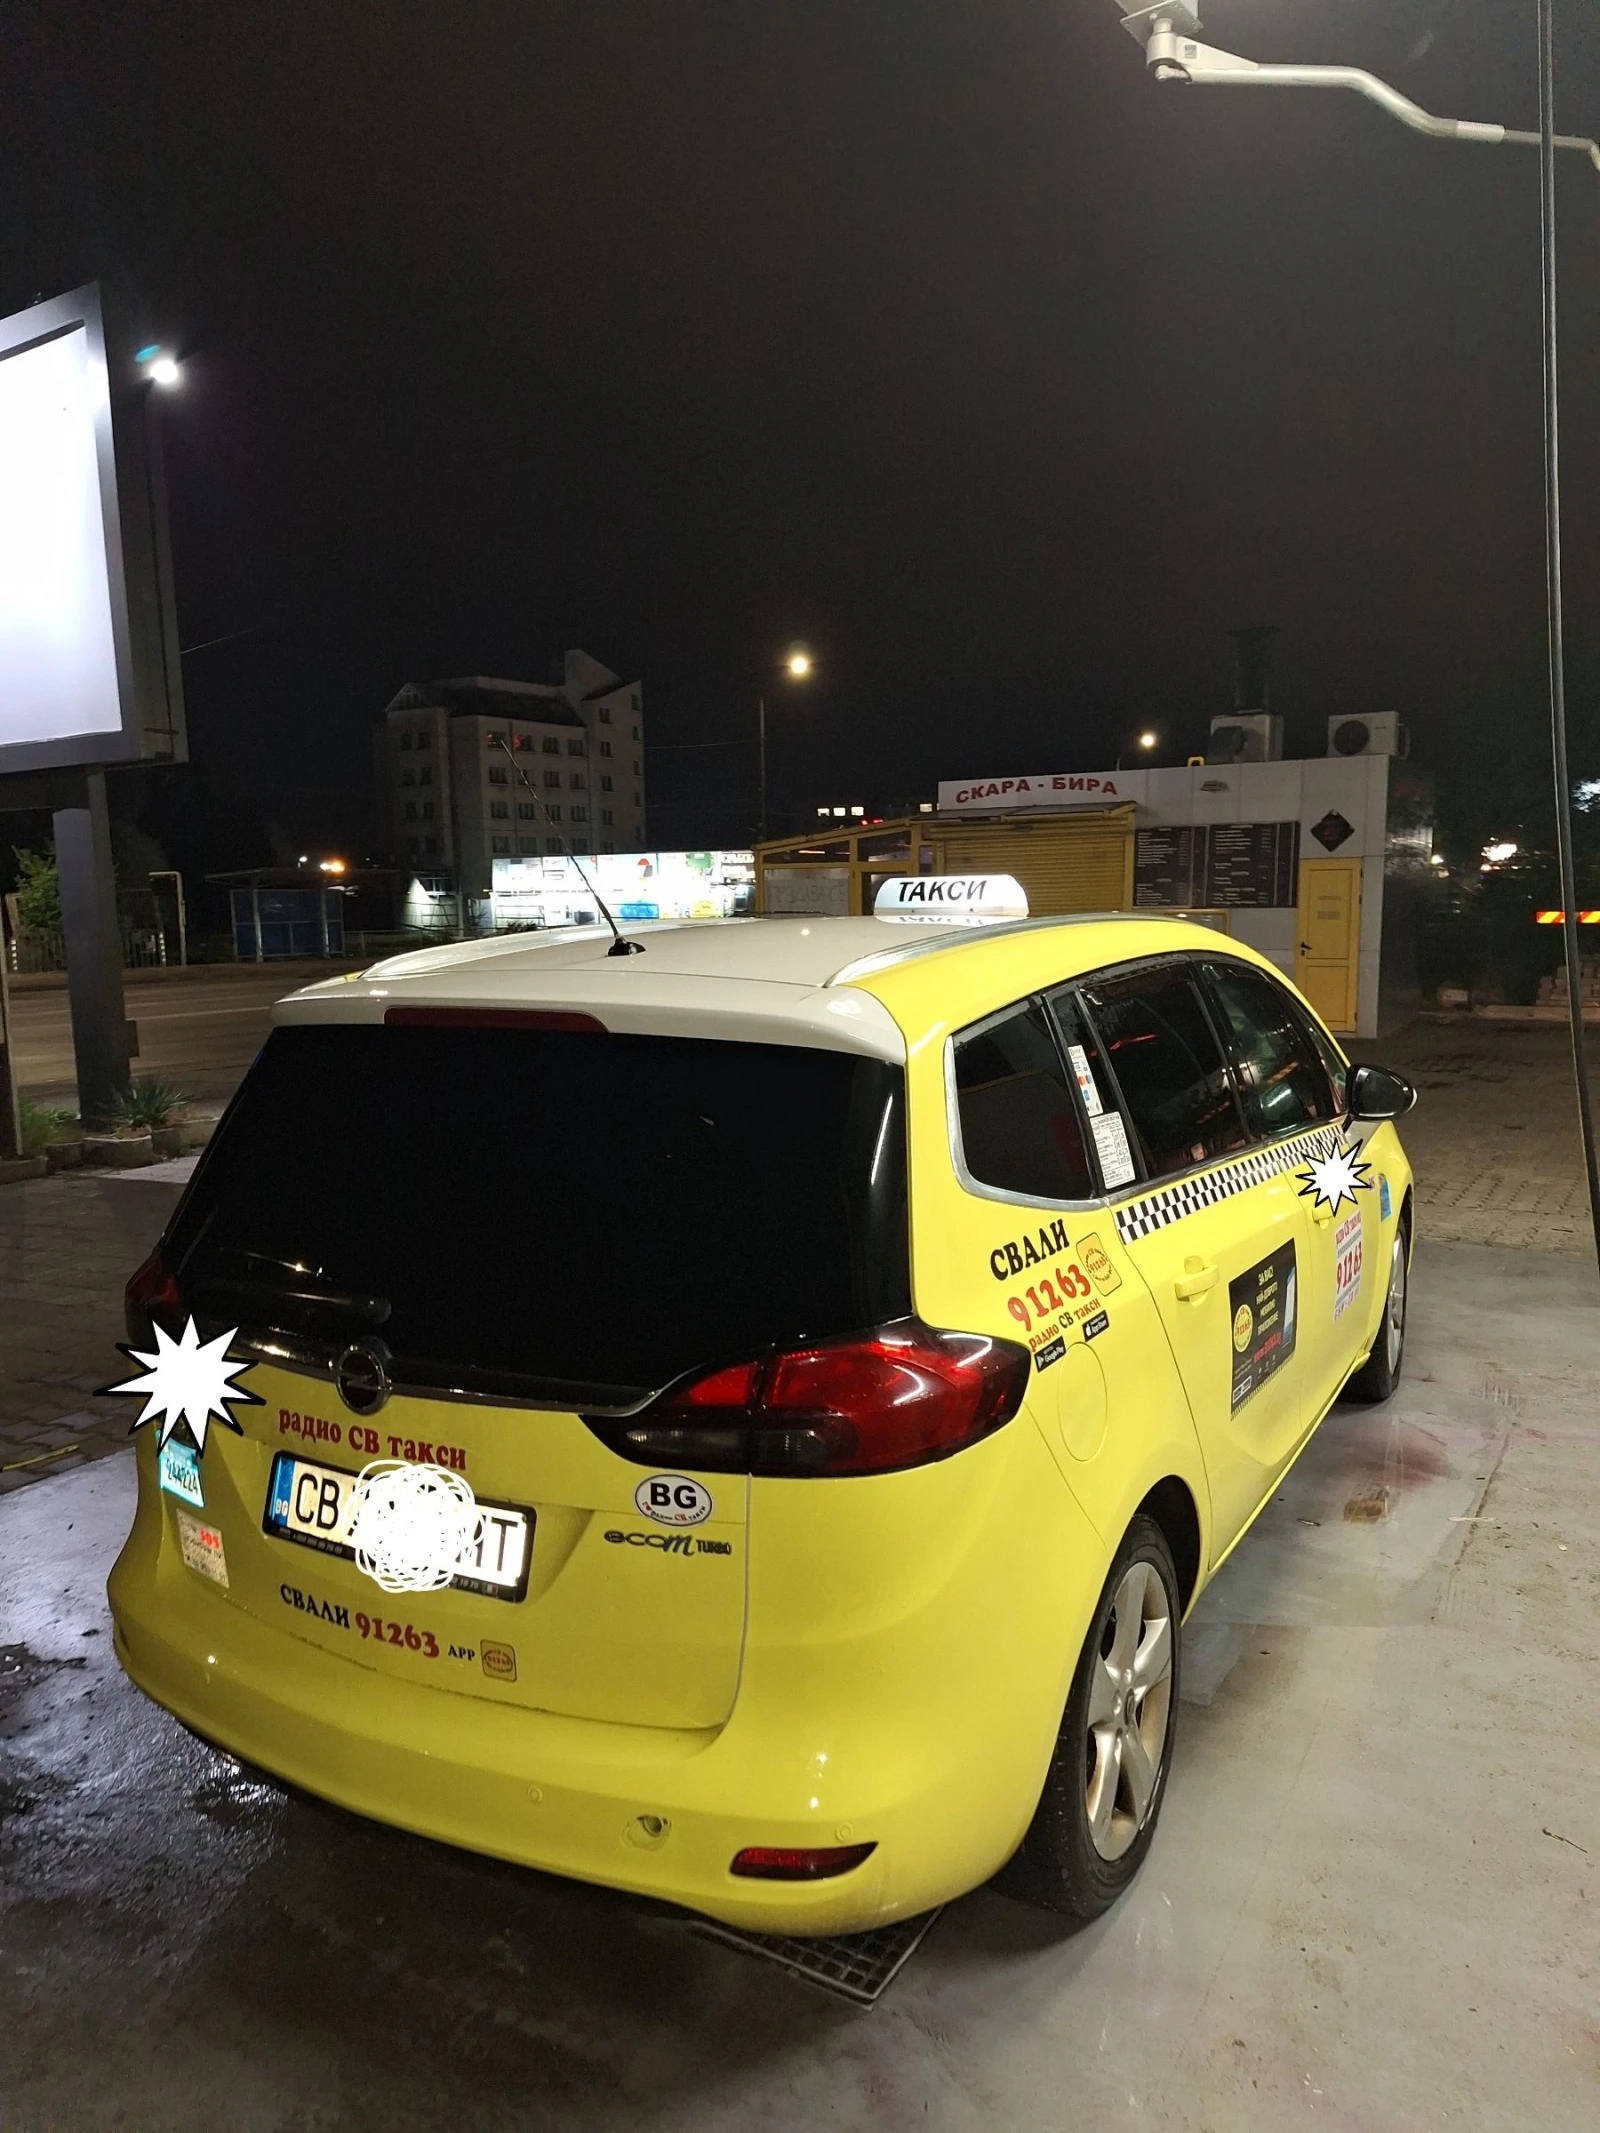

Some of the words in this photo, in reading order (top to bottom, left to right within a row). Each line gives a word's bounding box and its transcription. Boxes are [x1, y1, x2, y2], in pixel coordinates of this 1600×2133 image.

[956, 779, 1031, 803] СКАРА
[1052, 777, 1118, 795] БИРА
[899, 880, 987, 902] ТАКСИ
[990, 1218, 1070, 1281] СВАЛИ
[1336, 1241, 1362, 1294] 91263
[1008, 1264, 1091, 1331] 91263
[1028, 1324, 1060, 1353] радио
[1058, 1311, 1074, 1329] СВ
[1074, 1298, 1101, 1321] такси
[278, 1409, 342, 1443] радио
[348, 1425, 380, 1454] СВ
[387, 1435, 467, 1470] такси
[650, 1482, 697, 1509] BG
[695, 1539, 732, 1555] TURBO
[280, 1583, 350, 1629] СВАЛИ
[355, 1611, 440, 1659] 91263
